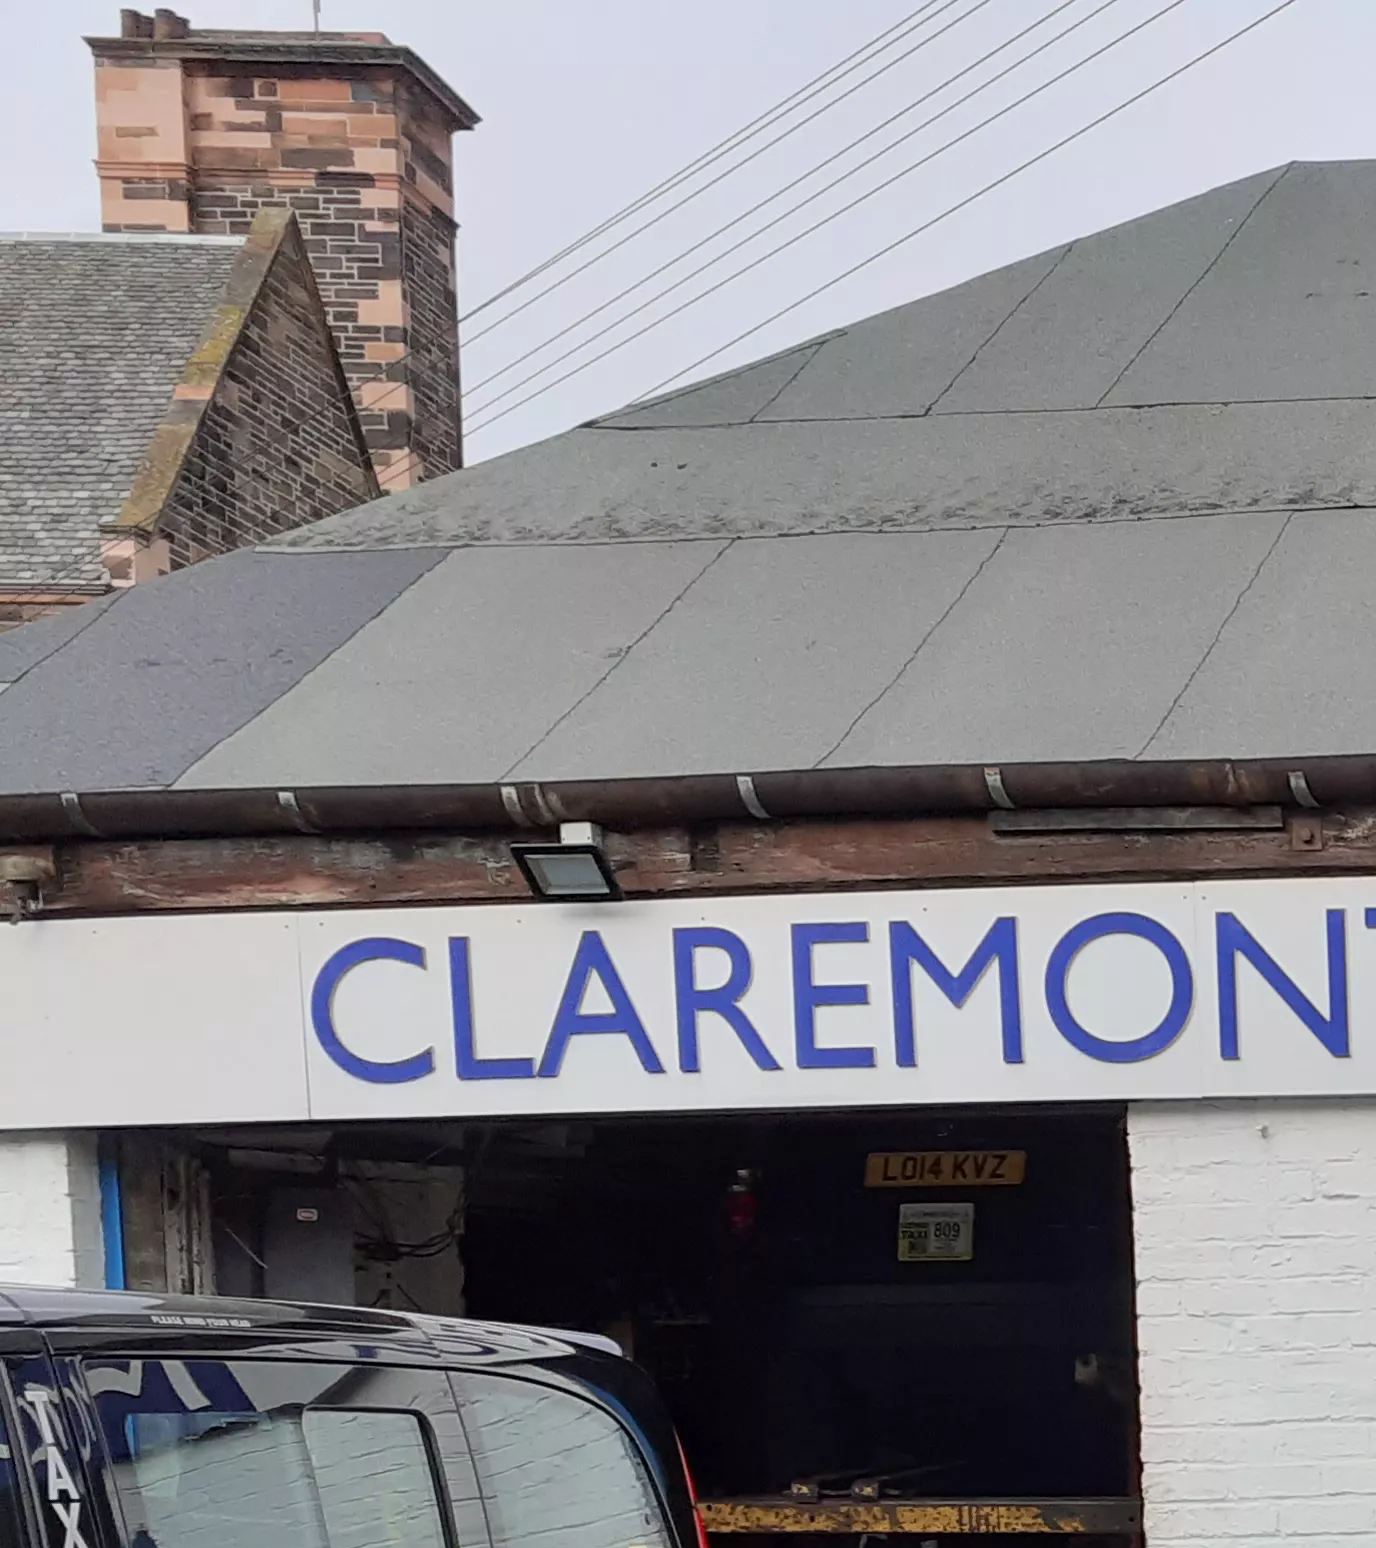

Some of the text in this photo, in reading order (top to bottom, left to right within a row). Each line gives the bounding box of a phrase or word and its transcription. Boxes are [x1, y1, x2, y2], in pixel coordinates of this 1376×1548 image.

[882, 1154, 1008, 1181] LO14 KVZ
[934, 1222, 960, 1238] 809
